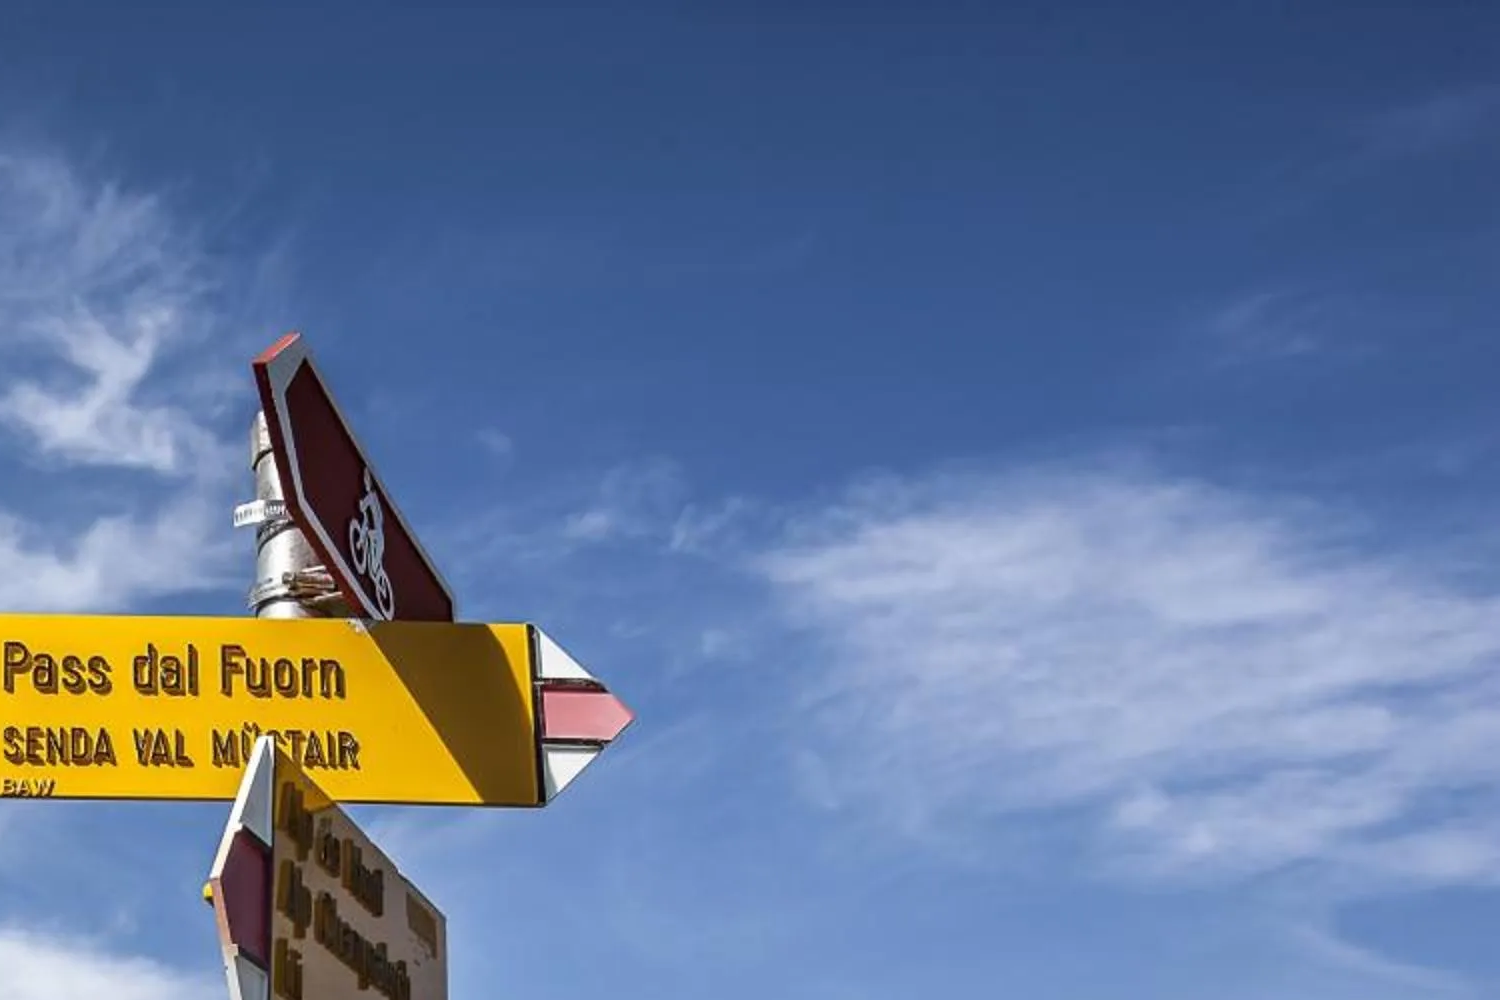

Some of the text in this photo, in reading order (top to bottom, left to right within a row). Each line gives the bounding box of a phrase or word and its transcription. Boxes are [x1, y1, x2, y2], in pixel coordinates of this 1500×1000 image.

[3, 641, 346, 697] Pass dal Fuorn
[3, 726, 117, 766] SENDA
[133, 727, 195, 768] VAL
[2, 778, 55, 797] BAW
